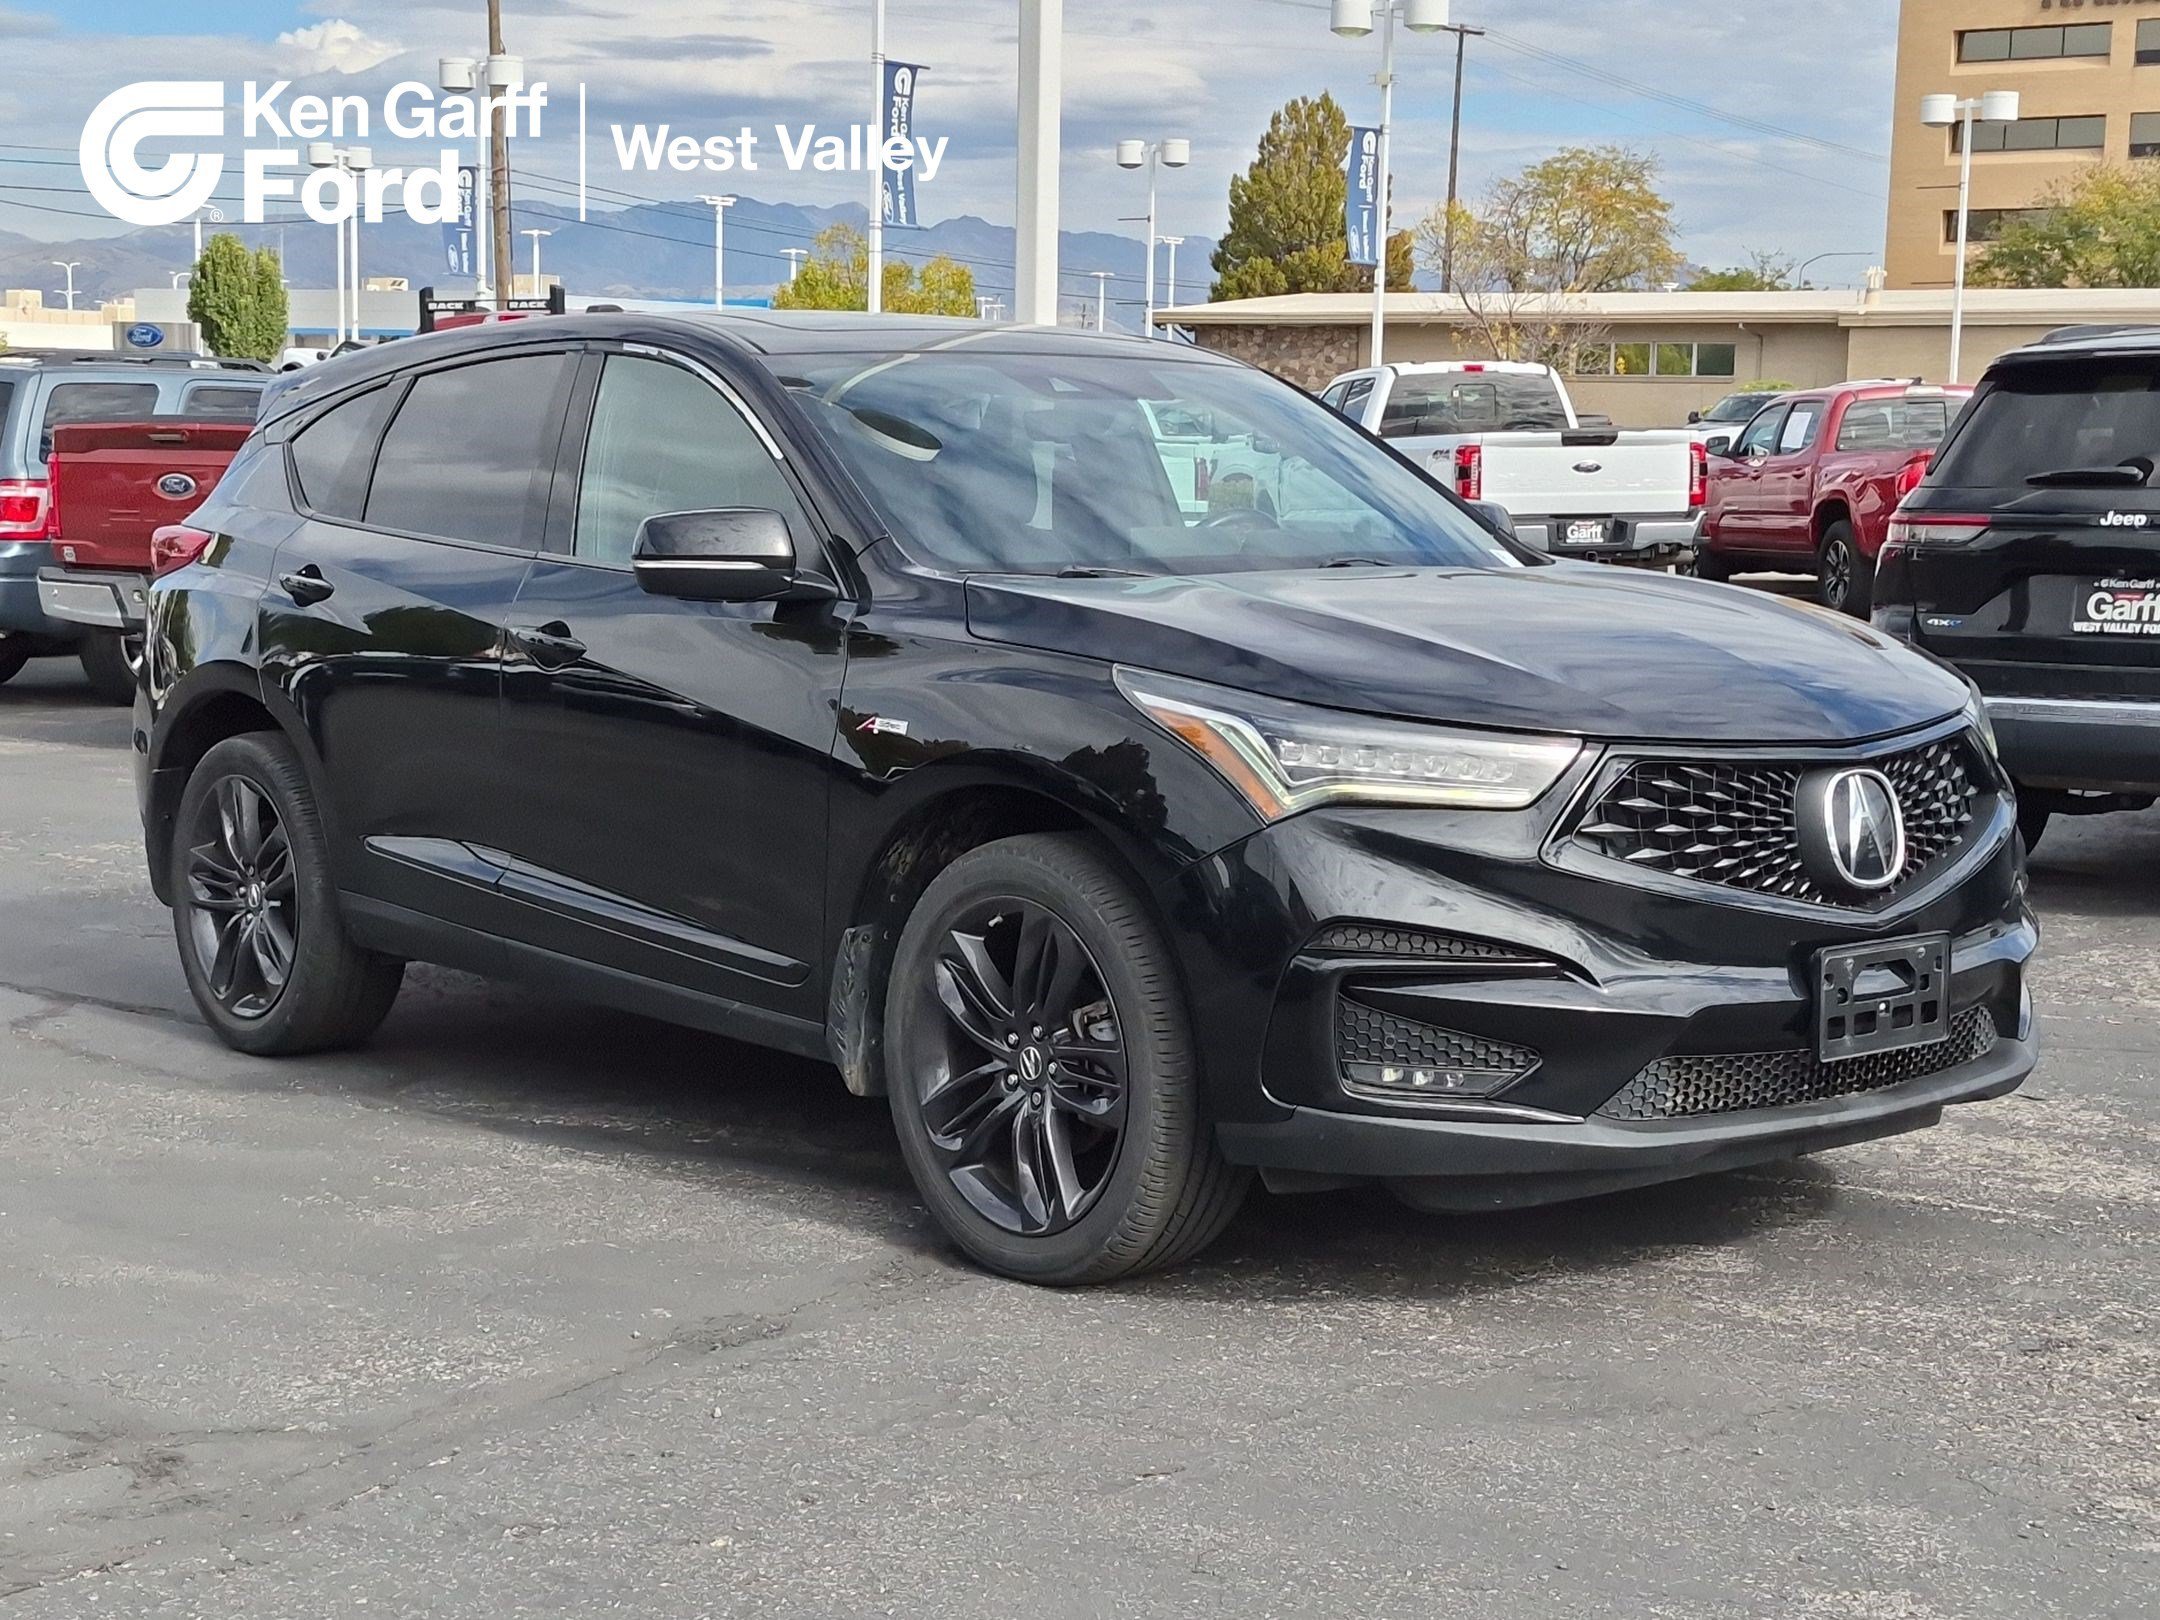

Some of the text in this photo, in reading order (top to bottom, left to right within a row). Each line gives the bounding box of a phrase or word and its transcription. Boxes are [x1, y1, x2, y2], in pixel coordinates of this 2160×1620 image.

[891, 96, 901, 137] Ford
[428, 301, 547, 310] BACK RACK
[2100, 510, 2147, 528] Jeep
[1567, 525, 1602, 539] Garff
[2073, 622, 2101, 632] WEST
[2103, 622, 2142, 633] VALLEY
